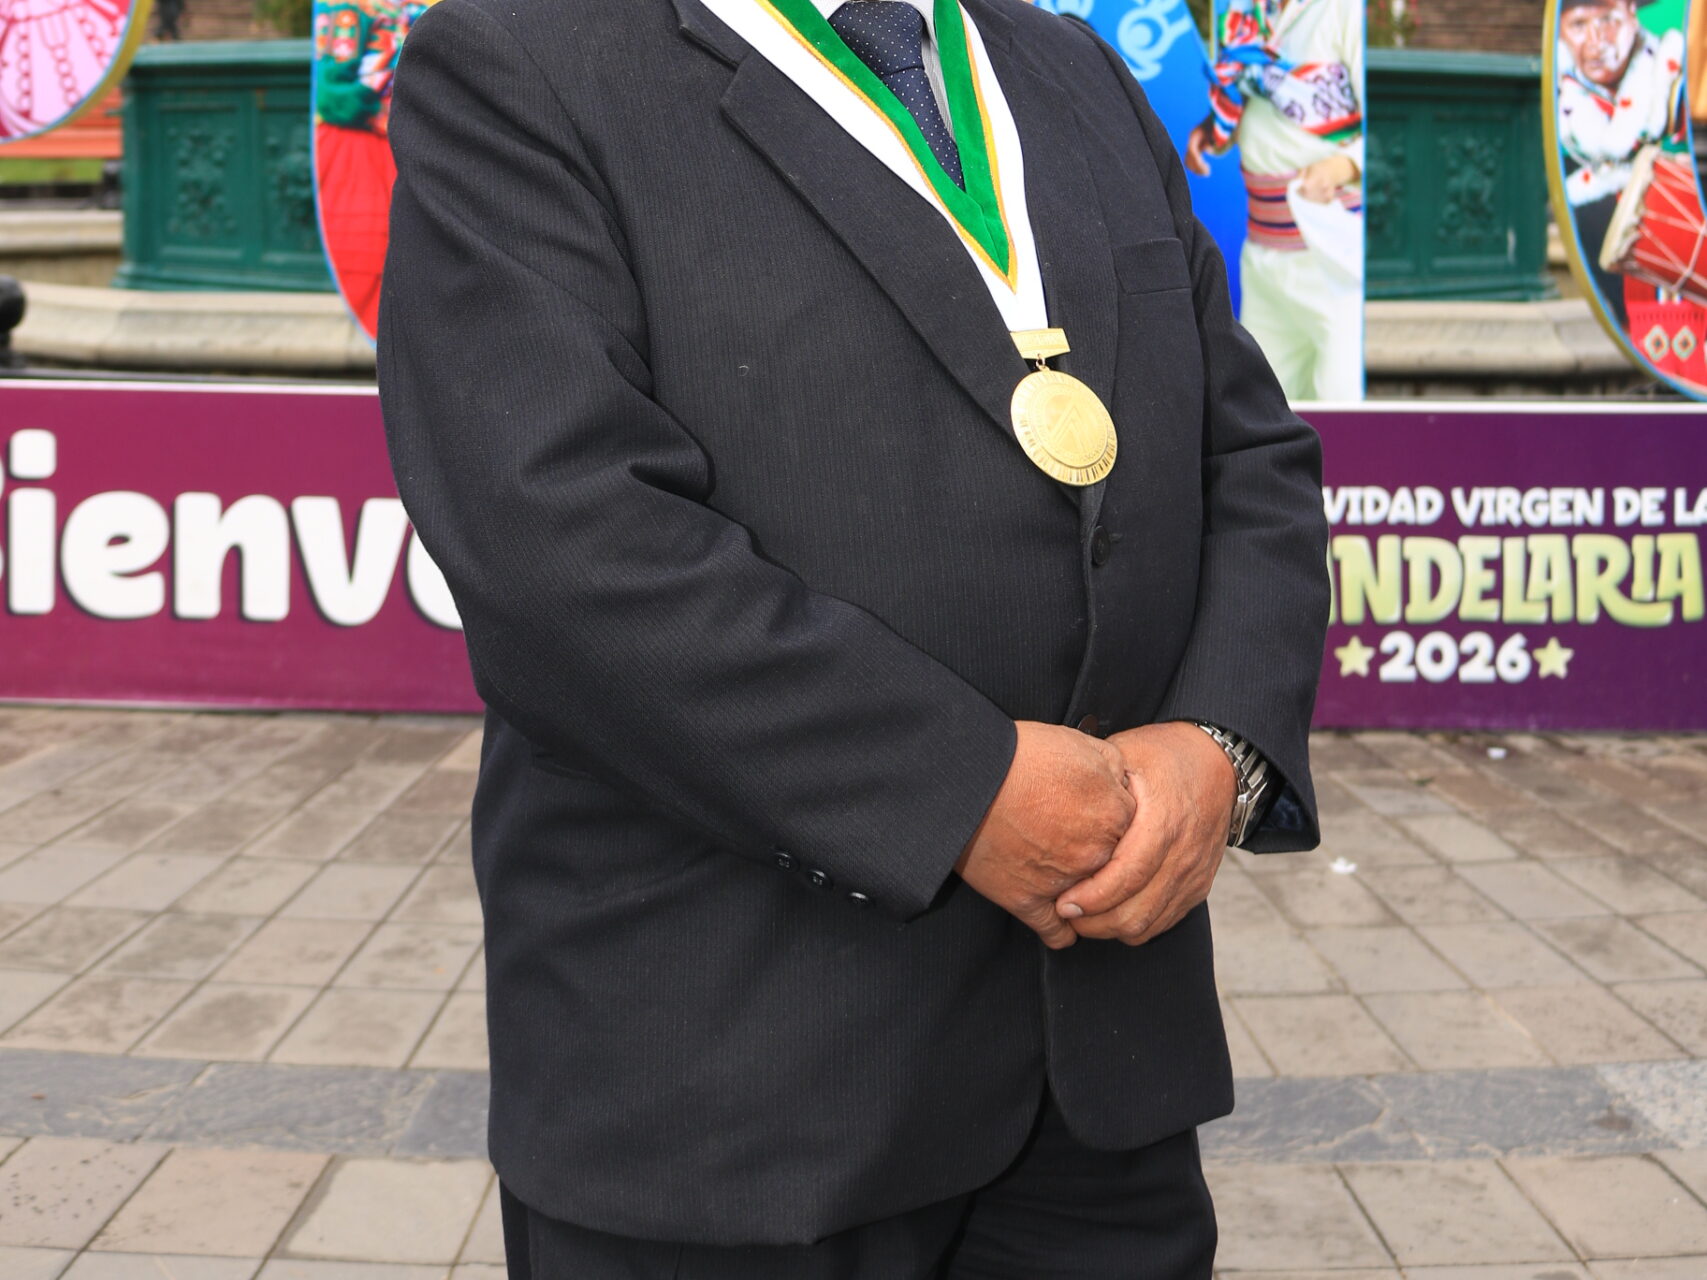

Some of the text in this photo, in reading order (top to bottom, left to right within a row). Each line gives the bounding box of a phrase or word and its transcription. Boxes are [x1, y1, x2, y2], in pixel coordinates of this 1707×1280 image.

[0, 429, 466, 630] ienv
[1322, 486, 1445, 526] VIDAD
[1451, 486, 1605, 527] VIRGEN
[1612, 486, 1667, 527] DE
[1327, 533, 1705, 627] NDELARIA
[1379, 631, 1532, 683] 2026
